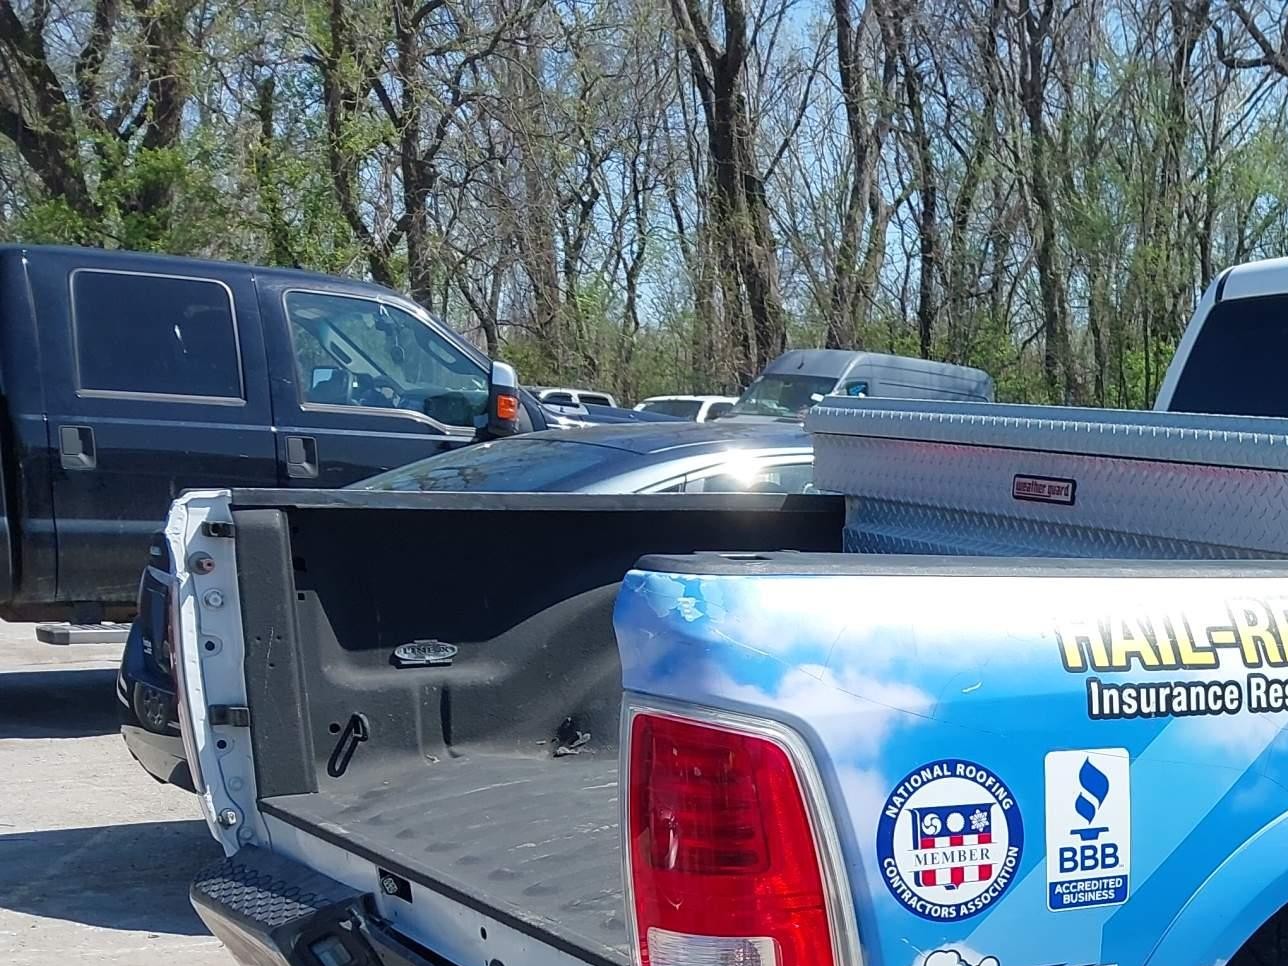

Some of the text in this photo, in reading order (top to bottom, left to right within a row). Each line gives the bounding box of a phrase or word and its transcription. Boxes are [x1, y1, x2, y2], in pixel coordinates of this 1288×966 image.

[1088, 677, 1242, 718] Insurance
[885, 763, 1014, 819] NATIONAL ROOFING
[914, 847, 991, 867] MEMBER
[1058, 843, 1119, 873] BBB
[883, 846, 1019, 918] CONTRACTORS ASSOCIATION
[1054, 878, 1122, 895] ACCREDITED
[1062, 890, 1115, 904] BUSINESS
